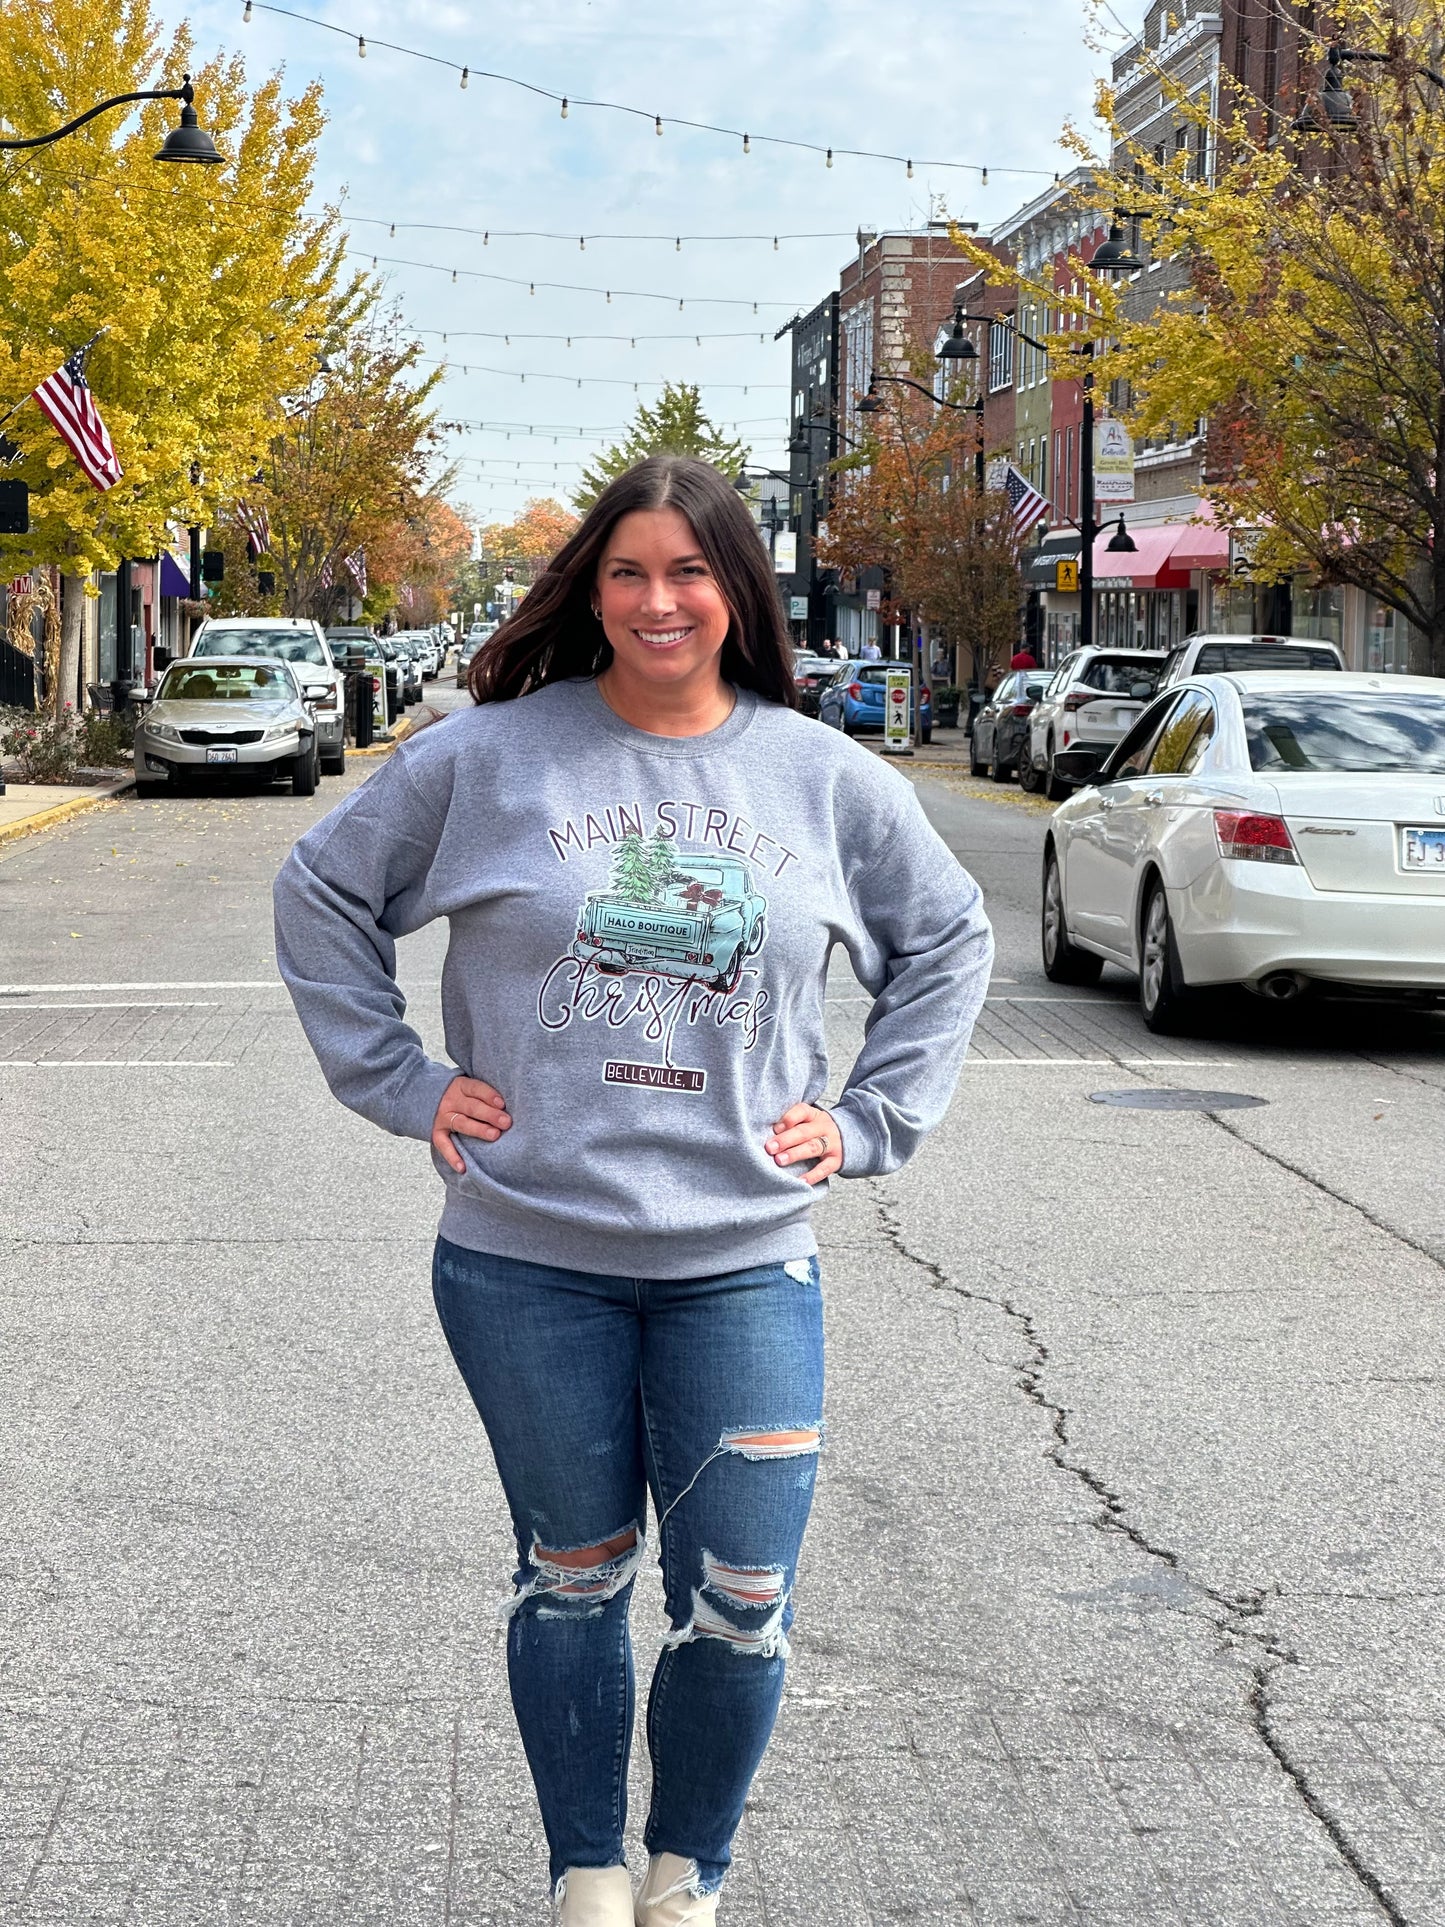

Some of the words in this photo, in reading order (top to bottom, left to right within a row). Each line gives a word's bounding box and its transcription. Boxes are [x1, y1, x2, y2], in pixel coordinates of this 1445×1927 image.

[549, 803, 644, 861] MAIN
[657, 801, 799, 877] STREET
[1407, 841, 1426, 862] FJ
[607, 916, 636, 929] HALO
[638, 921, 689, 936] BOUTIQUE
[627, 945, 655, 957] Tradition
[539, 947, 774, 1069] Christmas
[607, 1064, 686, 1088] BELLEVILLE,
[691, 1073, 702, 1088] IL
